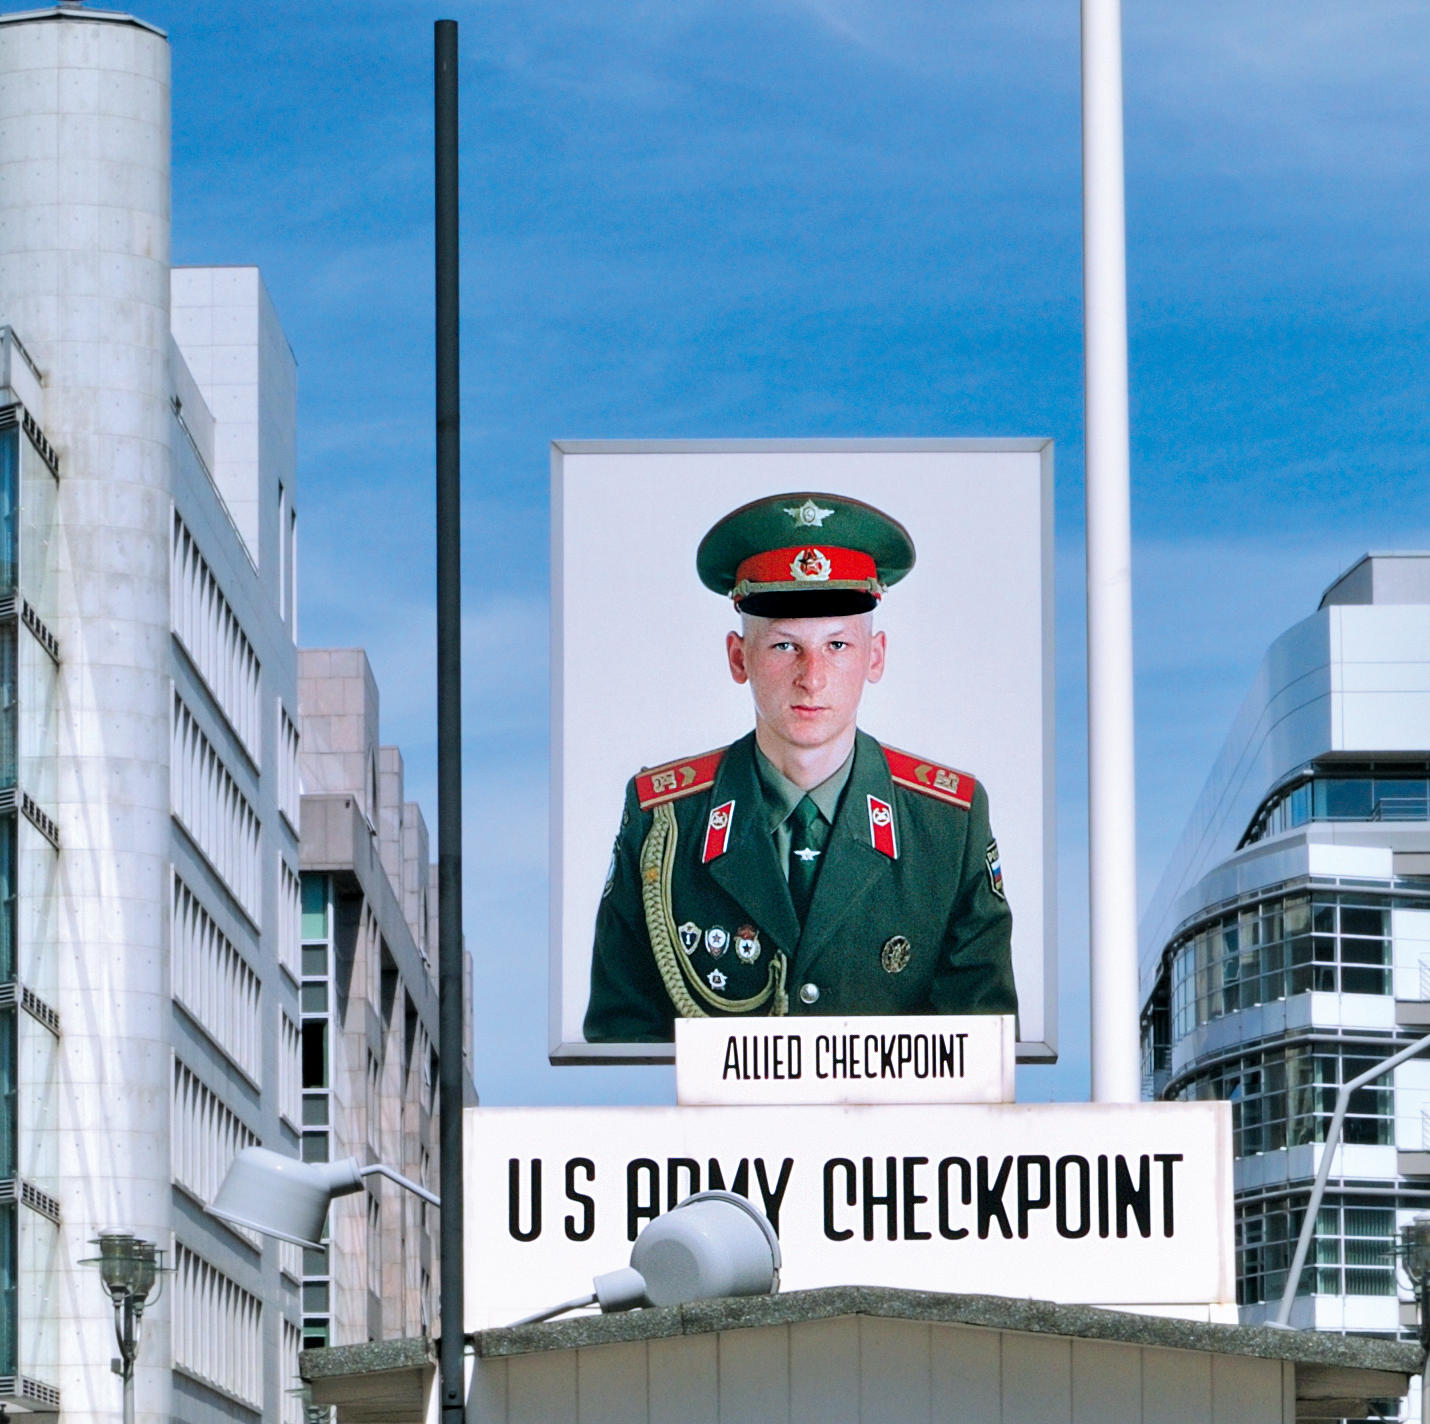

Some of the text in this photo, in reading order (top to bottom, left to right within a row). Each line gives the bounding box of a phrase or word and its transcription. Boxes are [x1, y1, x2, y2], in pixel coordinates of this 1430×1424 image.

[723, 1033, 968, 1080] ALLIED CHECKPOINT
[823, 1154, 1183, 1242] CHECKPOINT
